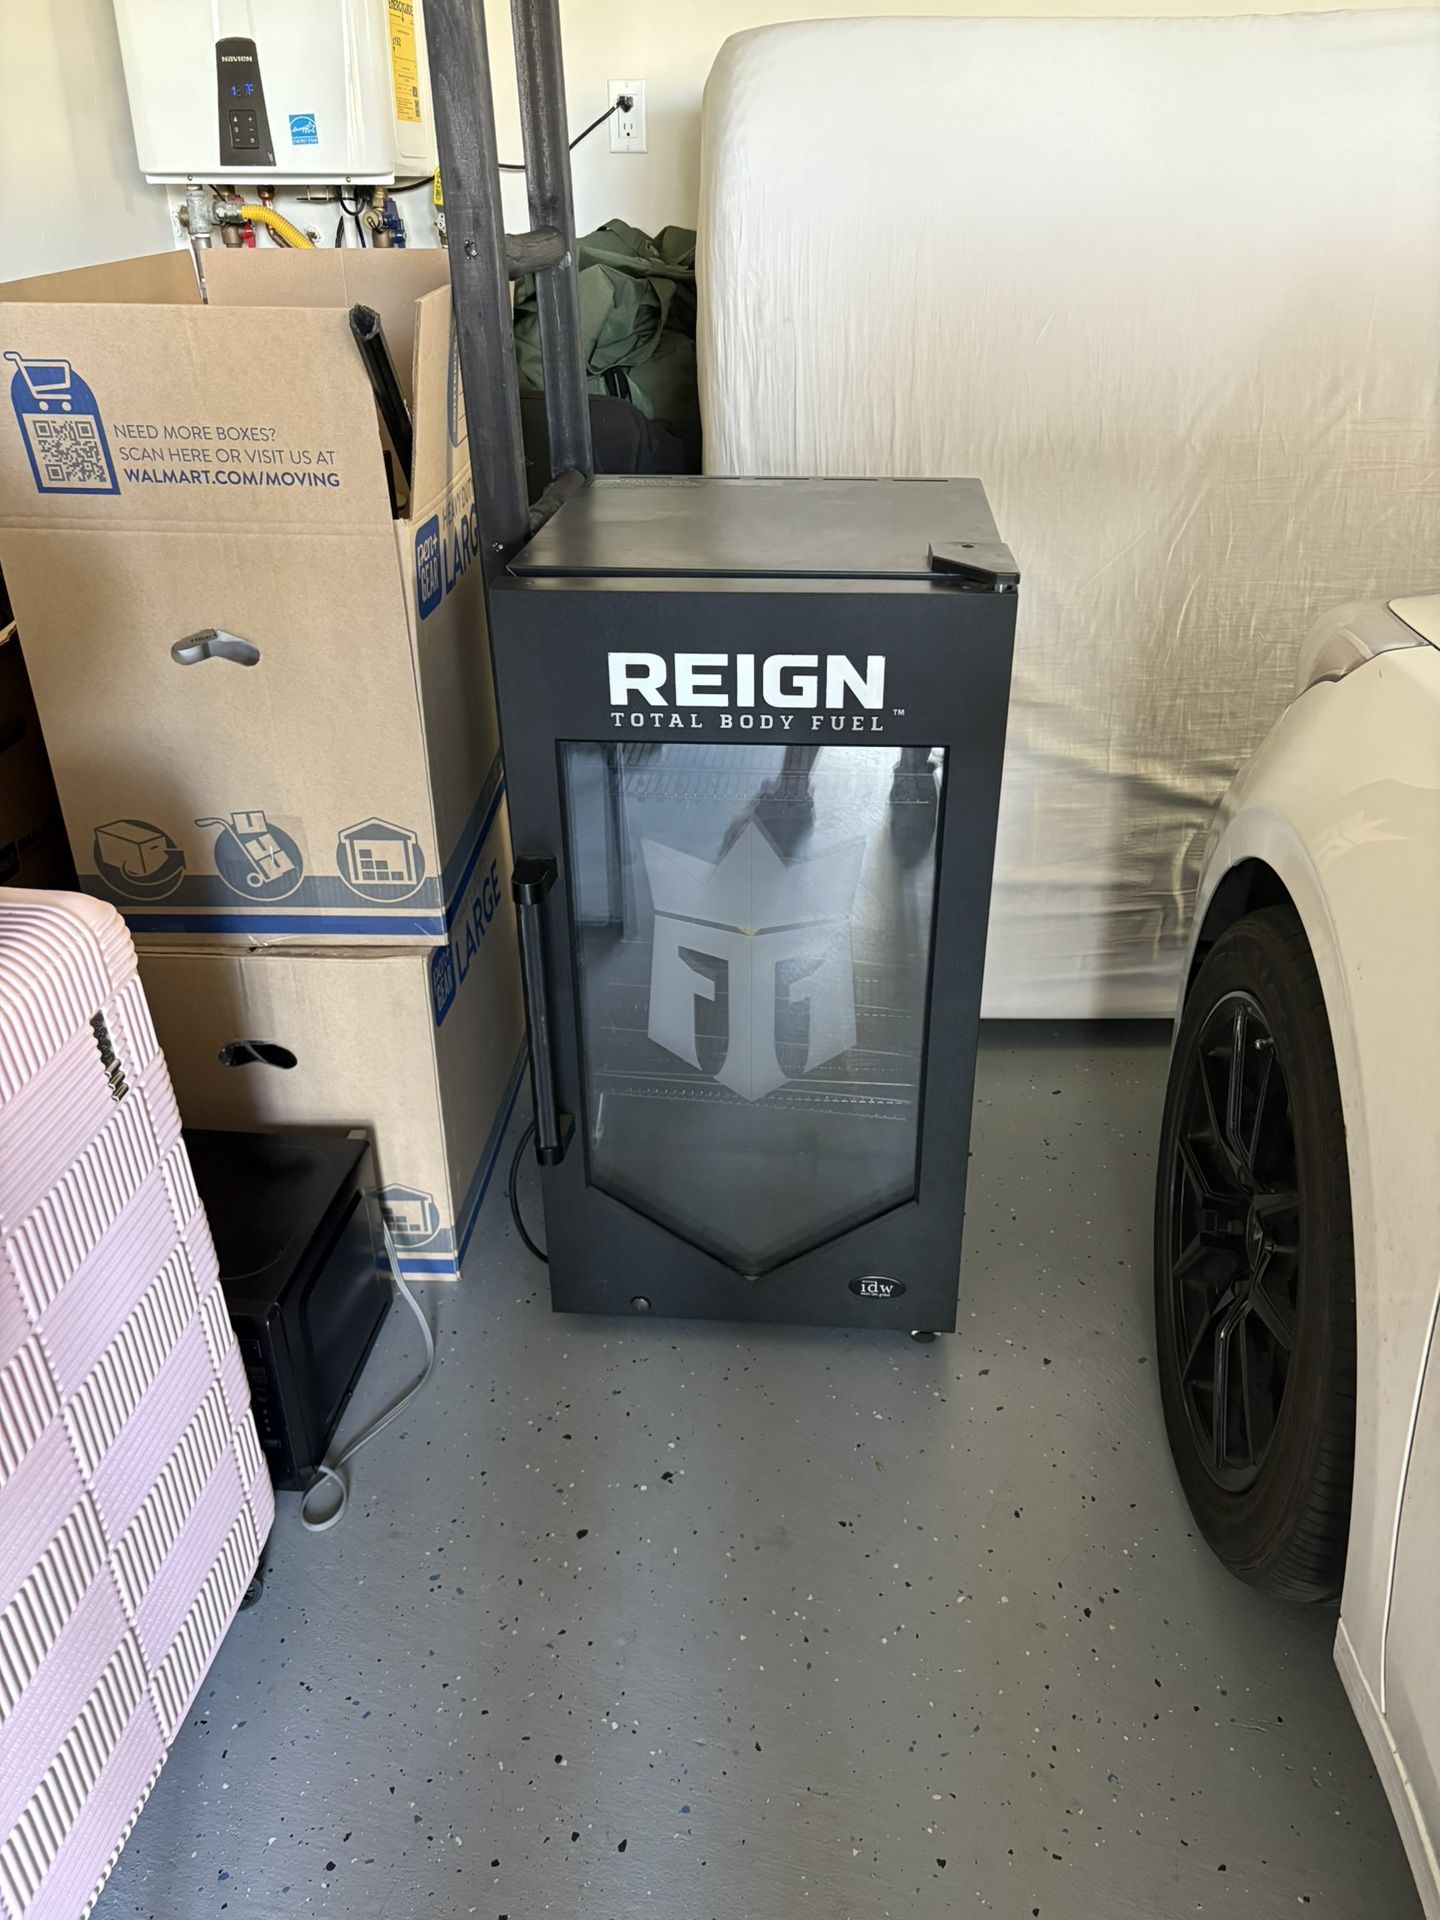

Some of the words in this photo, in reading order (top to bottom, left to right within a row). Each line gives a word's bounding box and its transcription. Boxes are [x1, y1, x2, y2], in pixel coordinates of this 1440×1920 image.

[113, 424, 158, 439] NEED
[164, 425, 213, 440] MORE
[218, 427, 276, 442] BOXES?
[119, 447, 164, 462] SCAN
[169, 448, 212, 463] HERE
[215, 448, 242, 464] OR
[244, 449, 284, 465] VISIT
[290, 450, 313, 465] US
[316, 451, 336, 465] AT
[124, 468, 340, 487] WALMART.COM/MOVING
[444, 503, 478, 595] LARG
[421, 556, 440, 603] GEAR
[608, 652, 886, 709] REIGN
[611, 712, 702, 728] TOTAL
[720, 714, 795, 730] BODY
[811, 716, 883, 731] FUEL
[456, 858, 501, 984] LARGE
[860, 1280, 893, 1293] idw
